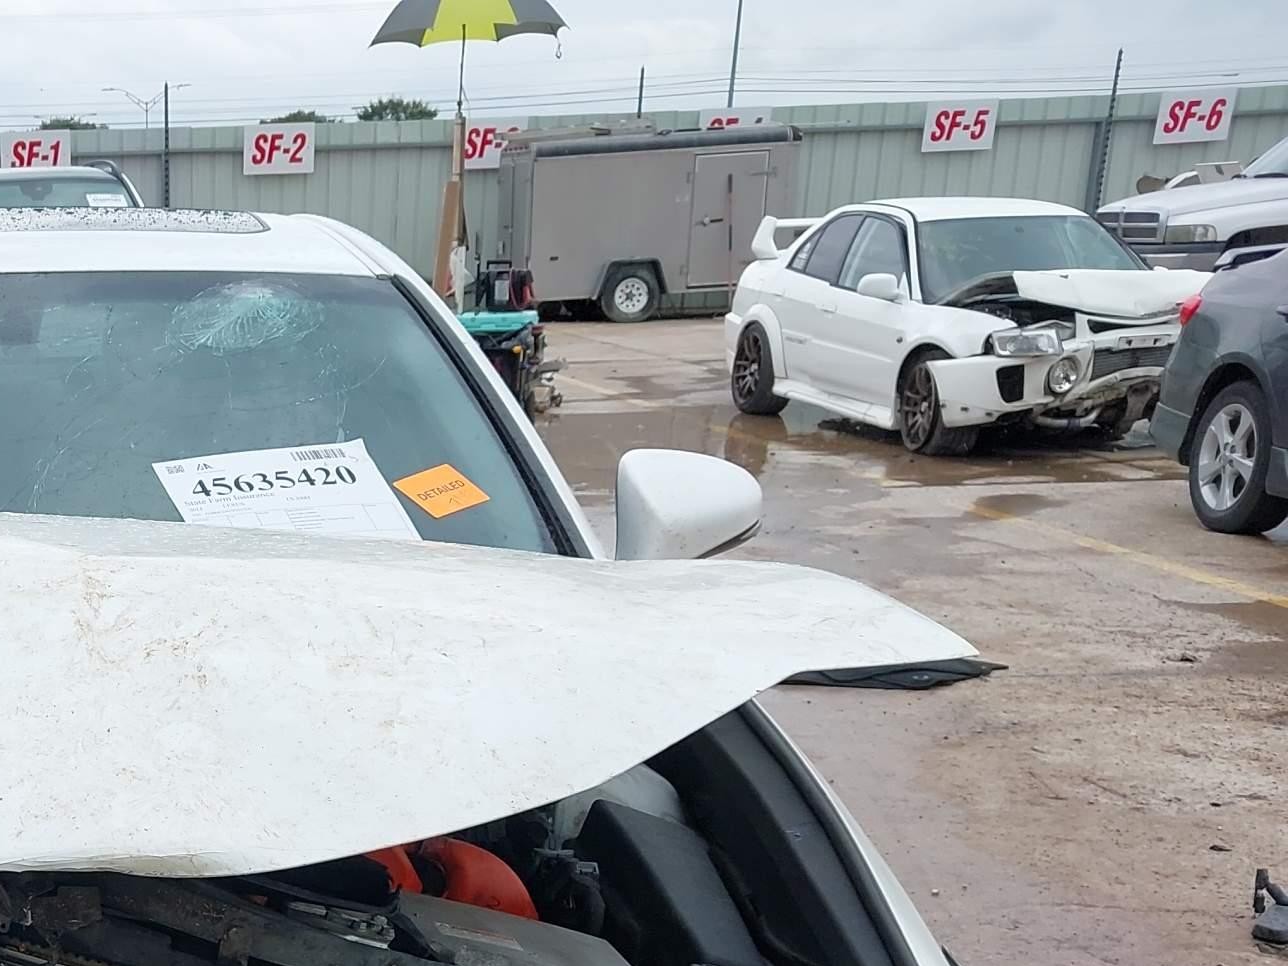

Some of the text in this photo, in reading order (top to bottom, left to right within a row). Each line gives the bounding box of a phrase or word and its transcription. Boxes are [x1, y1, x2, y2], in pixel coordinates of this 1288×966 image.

[930, 109, 990, 142] SF-5
[1163, 98, 1227, 133] SF-6
[11, 140, 61, 168] SF-1
[251, 132, 307, 165] SF-2
[464, 127, 520, 159] SF-
[192, 465, 357, 497] 45635420
[416, 480, 465, 501] DETAILED
